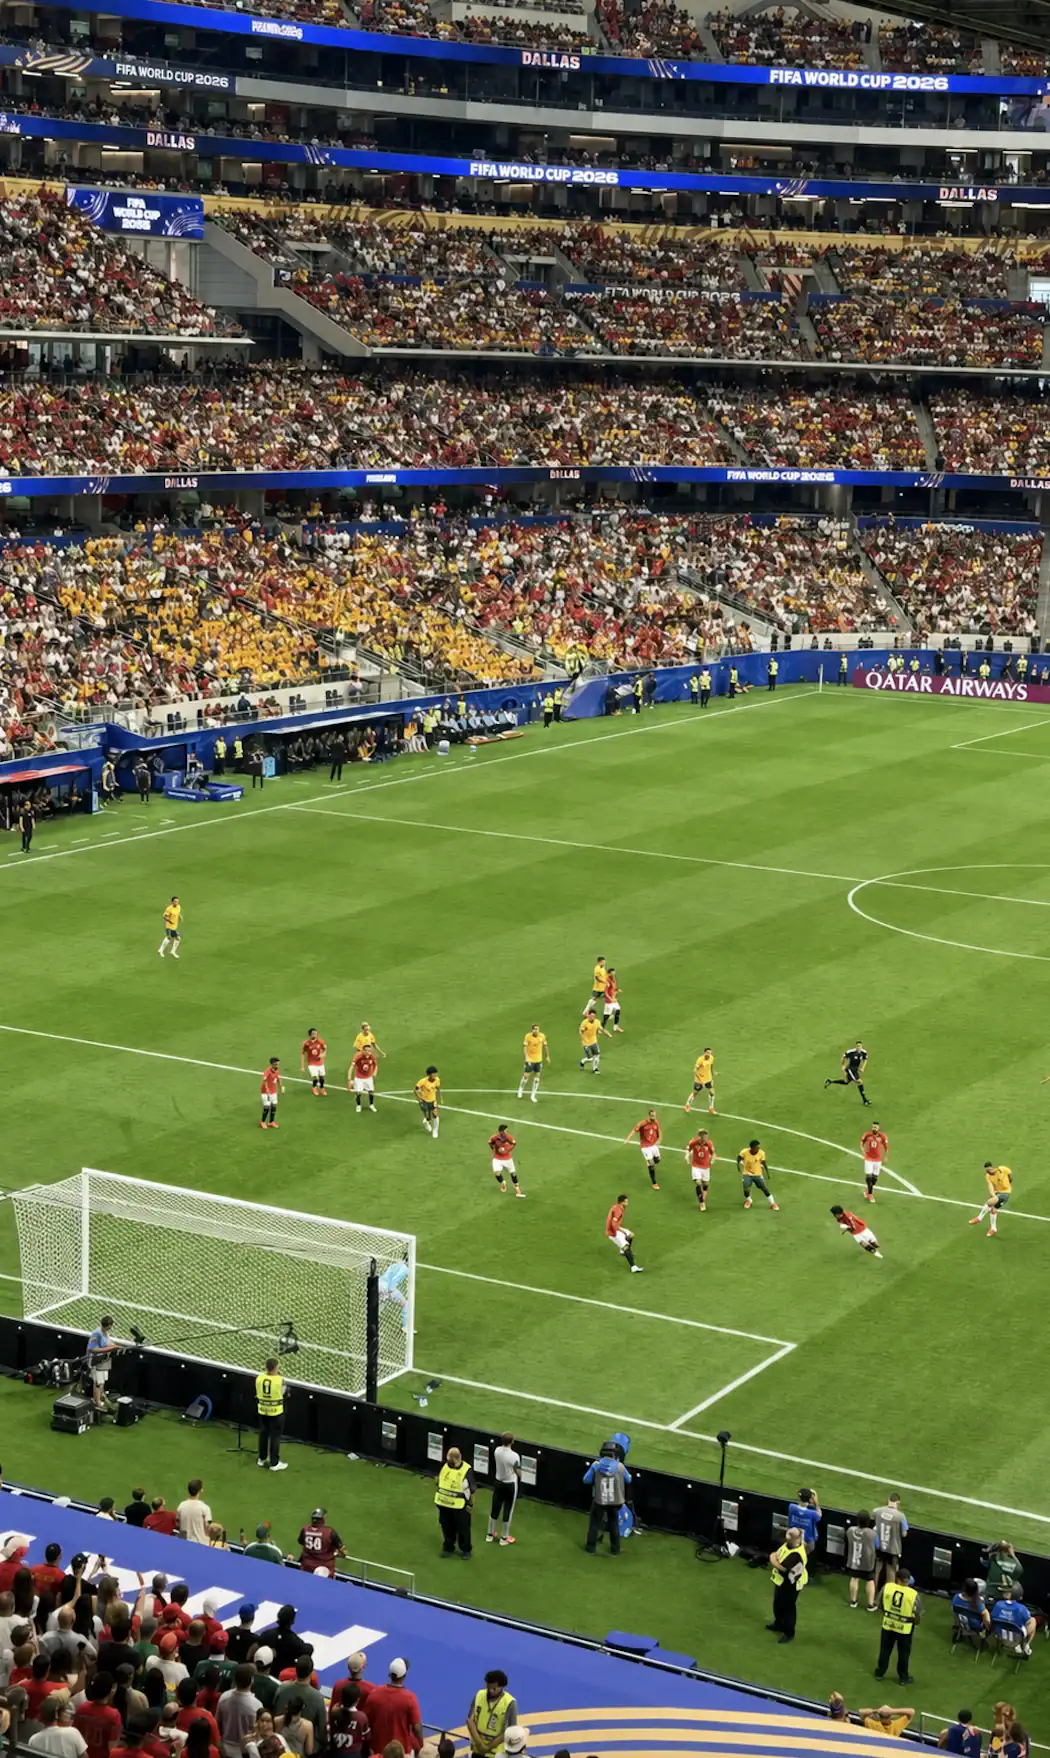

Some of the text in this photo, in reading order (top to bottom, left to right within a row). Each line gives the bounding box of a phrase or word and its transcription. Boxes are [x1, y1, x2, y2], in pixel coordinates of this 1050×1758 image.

[522, 51, 580, 69] DALLAS
[116, 63, 229, 88] FIFA WORLD CUP 2026
[769, 70, 948, 90] FIFA WORLD CUP 2026
[146, 132, 195, 150] DALLAS
[470, 163, 619, 184] FIFA WORLD CUP 2026
[939, 187, 998, 201] DALLAS
[164, 478, 198, 488] DALLAS
[727, 470, 747, 480] FIFA
[747, 471, 780, 480] WORLD
[780, 471, 800, 481] CUP
[865, 671, 1028, 700] QATAR AIRWAYS
